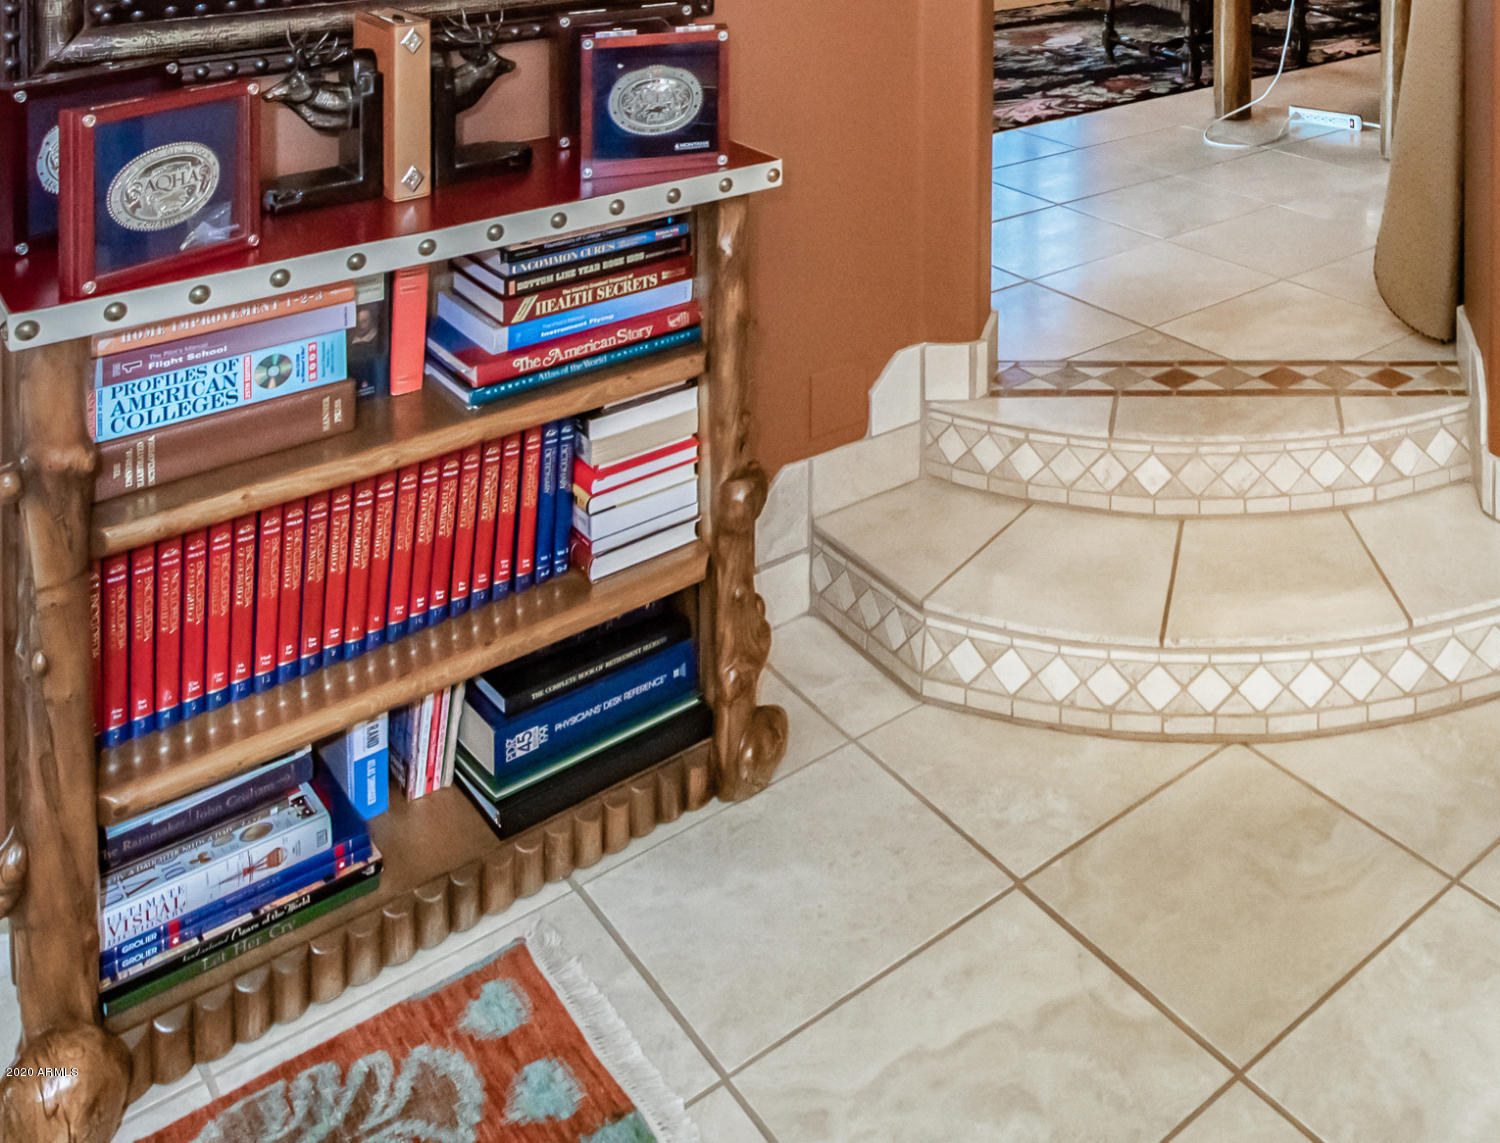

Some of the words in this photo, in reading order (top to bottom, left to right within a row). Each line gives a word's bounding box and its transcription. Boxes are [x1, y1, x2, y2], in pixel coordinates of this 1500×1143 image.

[145, 168, 199, 193] AQHA
[511, 251, 579, 275] UNCOMMON
[580, 242, 616, 258] CURES
[534, 289, 594, 317] HEALTH
[596, 273, 659, 302] SECRETS
[121, 325, 166, 344] HOME
[171, 300, 278, 332] IMPROVEMENT
[286, 291, 324, 308] 1-2-3
[540, 320, 588, 338] Instrument
[589, 313, 615, 327] Flying
[148, 354, 183, 371] Flight
[186, 345, 228, 362] School
[512, 354, 541, 373] The
[542, 333, 617, 367] American
[616, 325, 654, 345] Story
[110, 365, 208, 400] PROFILES
[213, 357, 240, 376] OF
[110, 371, 239, 418] AMERICAN
[110, 388, 240, 434] COLLEGES
[531, 687, 545, 701] THE
[602, 693, 623, 711] DESK
[366, 723, 380, 749] RAND
[516, 729, 533, 753] 45
[121, 819, 185, 851] Rainmaker
[107, 885, 186, 924] ULTIMATE
[109, 896, 186, 937] VISUAL
[121, 931, 158, 954] GROLIER
[121, 946, 158, 968] GROLIER
